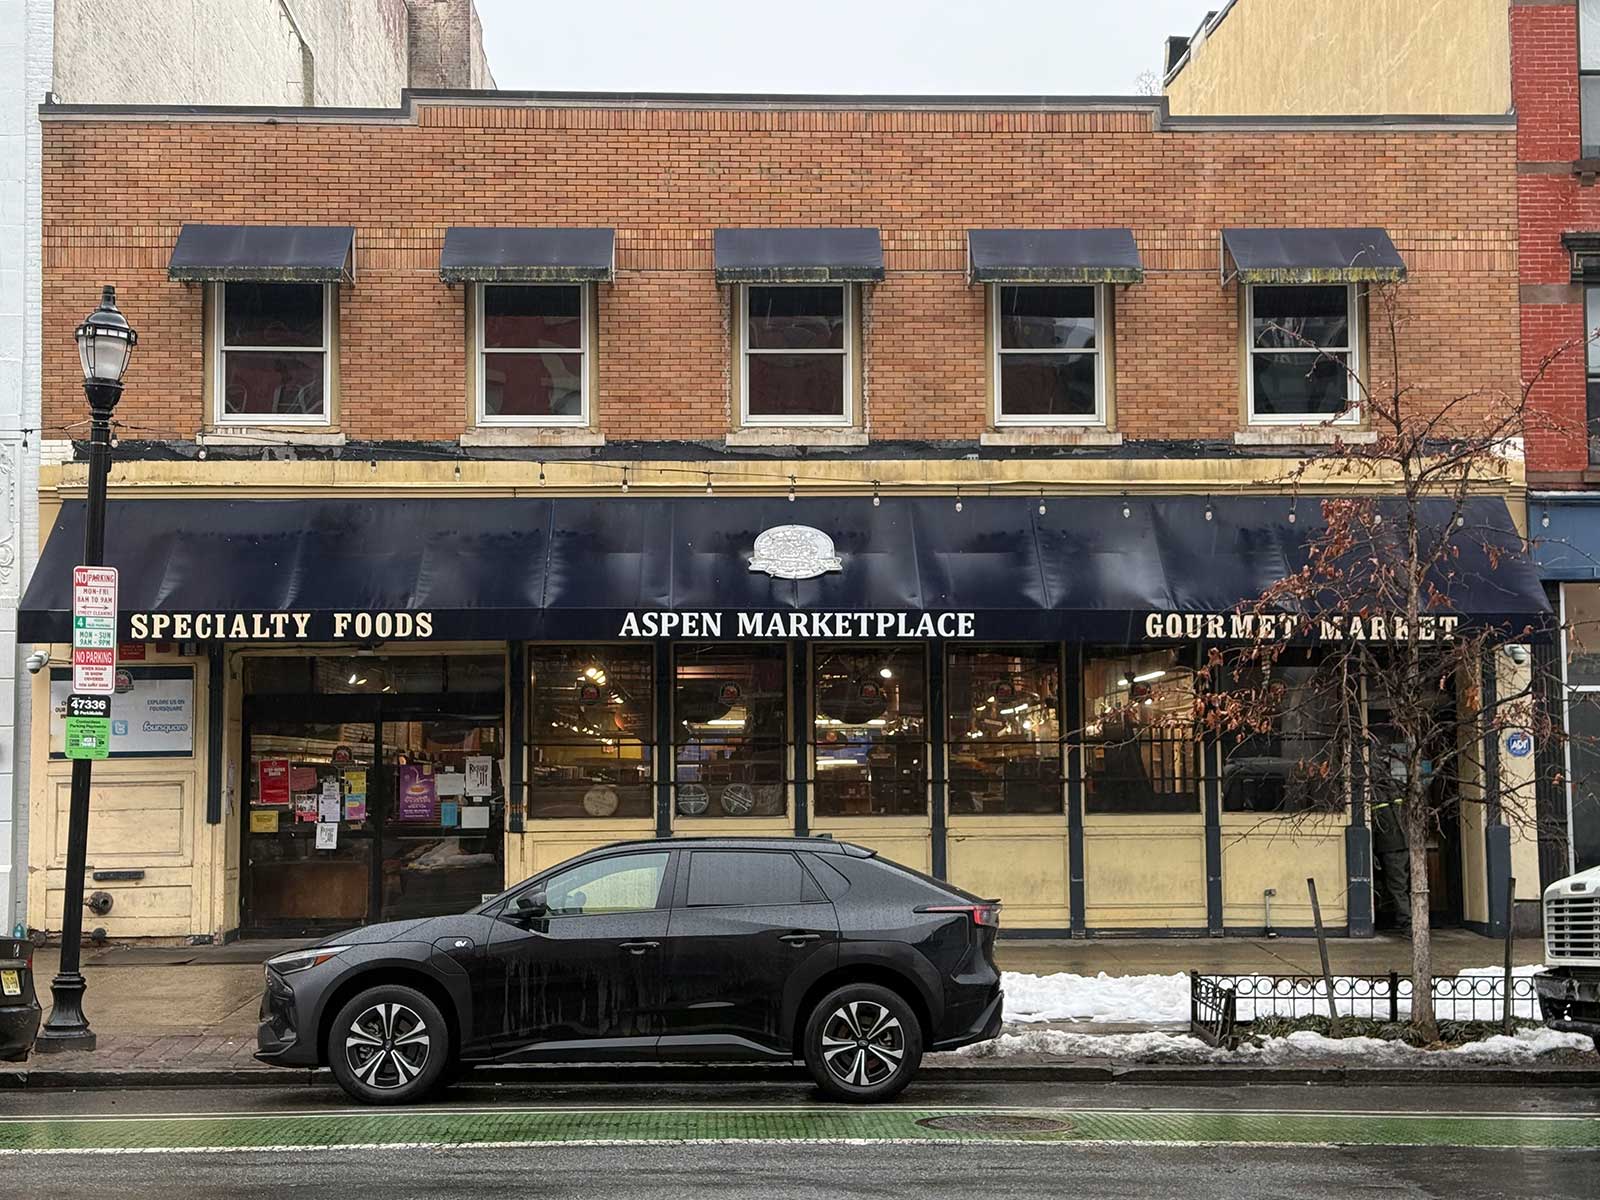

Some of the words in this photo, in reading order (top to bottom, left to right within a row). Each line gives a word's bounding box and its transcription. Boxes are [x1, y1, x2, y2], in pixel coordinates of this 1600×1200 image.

[76, 572, 87, 584] NO
[88, 574, 114, 582] PARKING
[77, 618, 84, 628] 4
[130, 613, 311, 639] SPECIALTY
[333, 612, 432, 638] FOODS
[618, 612, 722, 637] ASPEN
[736, 612, 975, 638] MARKETPLACE
[1145, 613, 1298, 639] GOURMET
[1319, 616, 1458, 640] MARKET
[76, 651, 86, 663] NO
[86, 651, 112, 664] PARKING
[70, 700, 106, 710] 47336
[143, 720, 188, 734] foursquare
[1510, 739, 1528, 750] ADT
